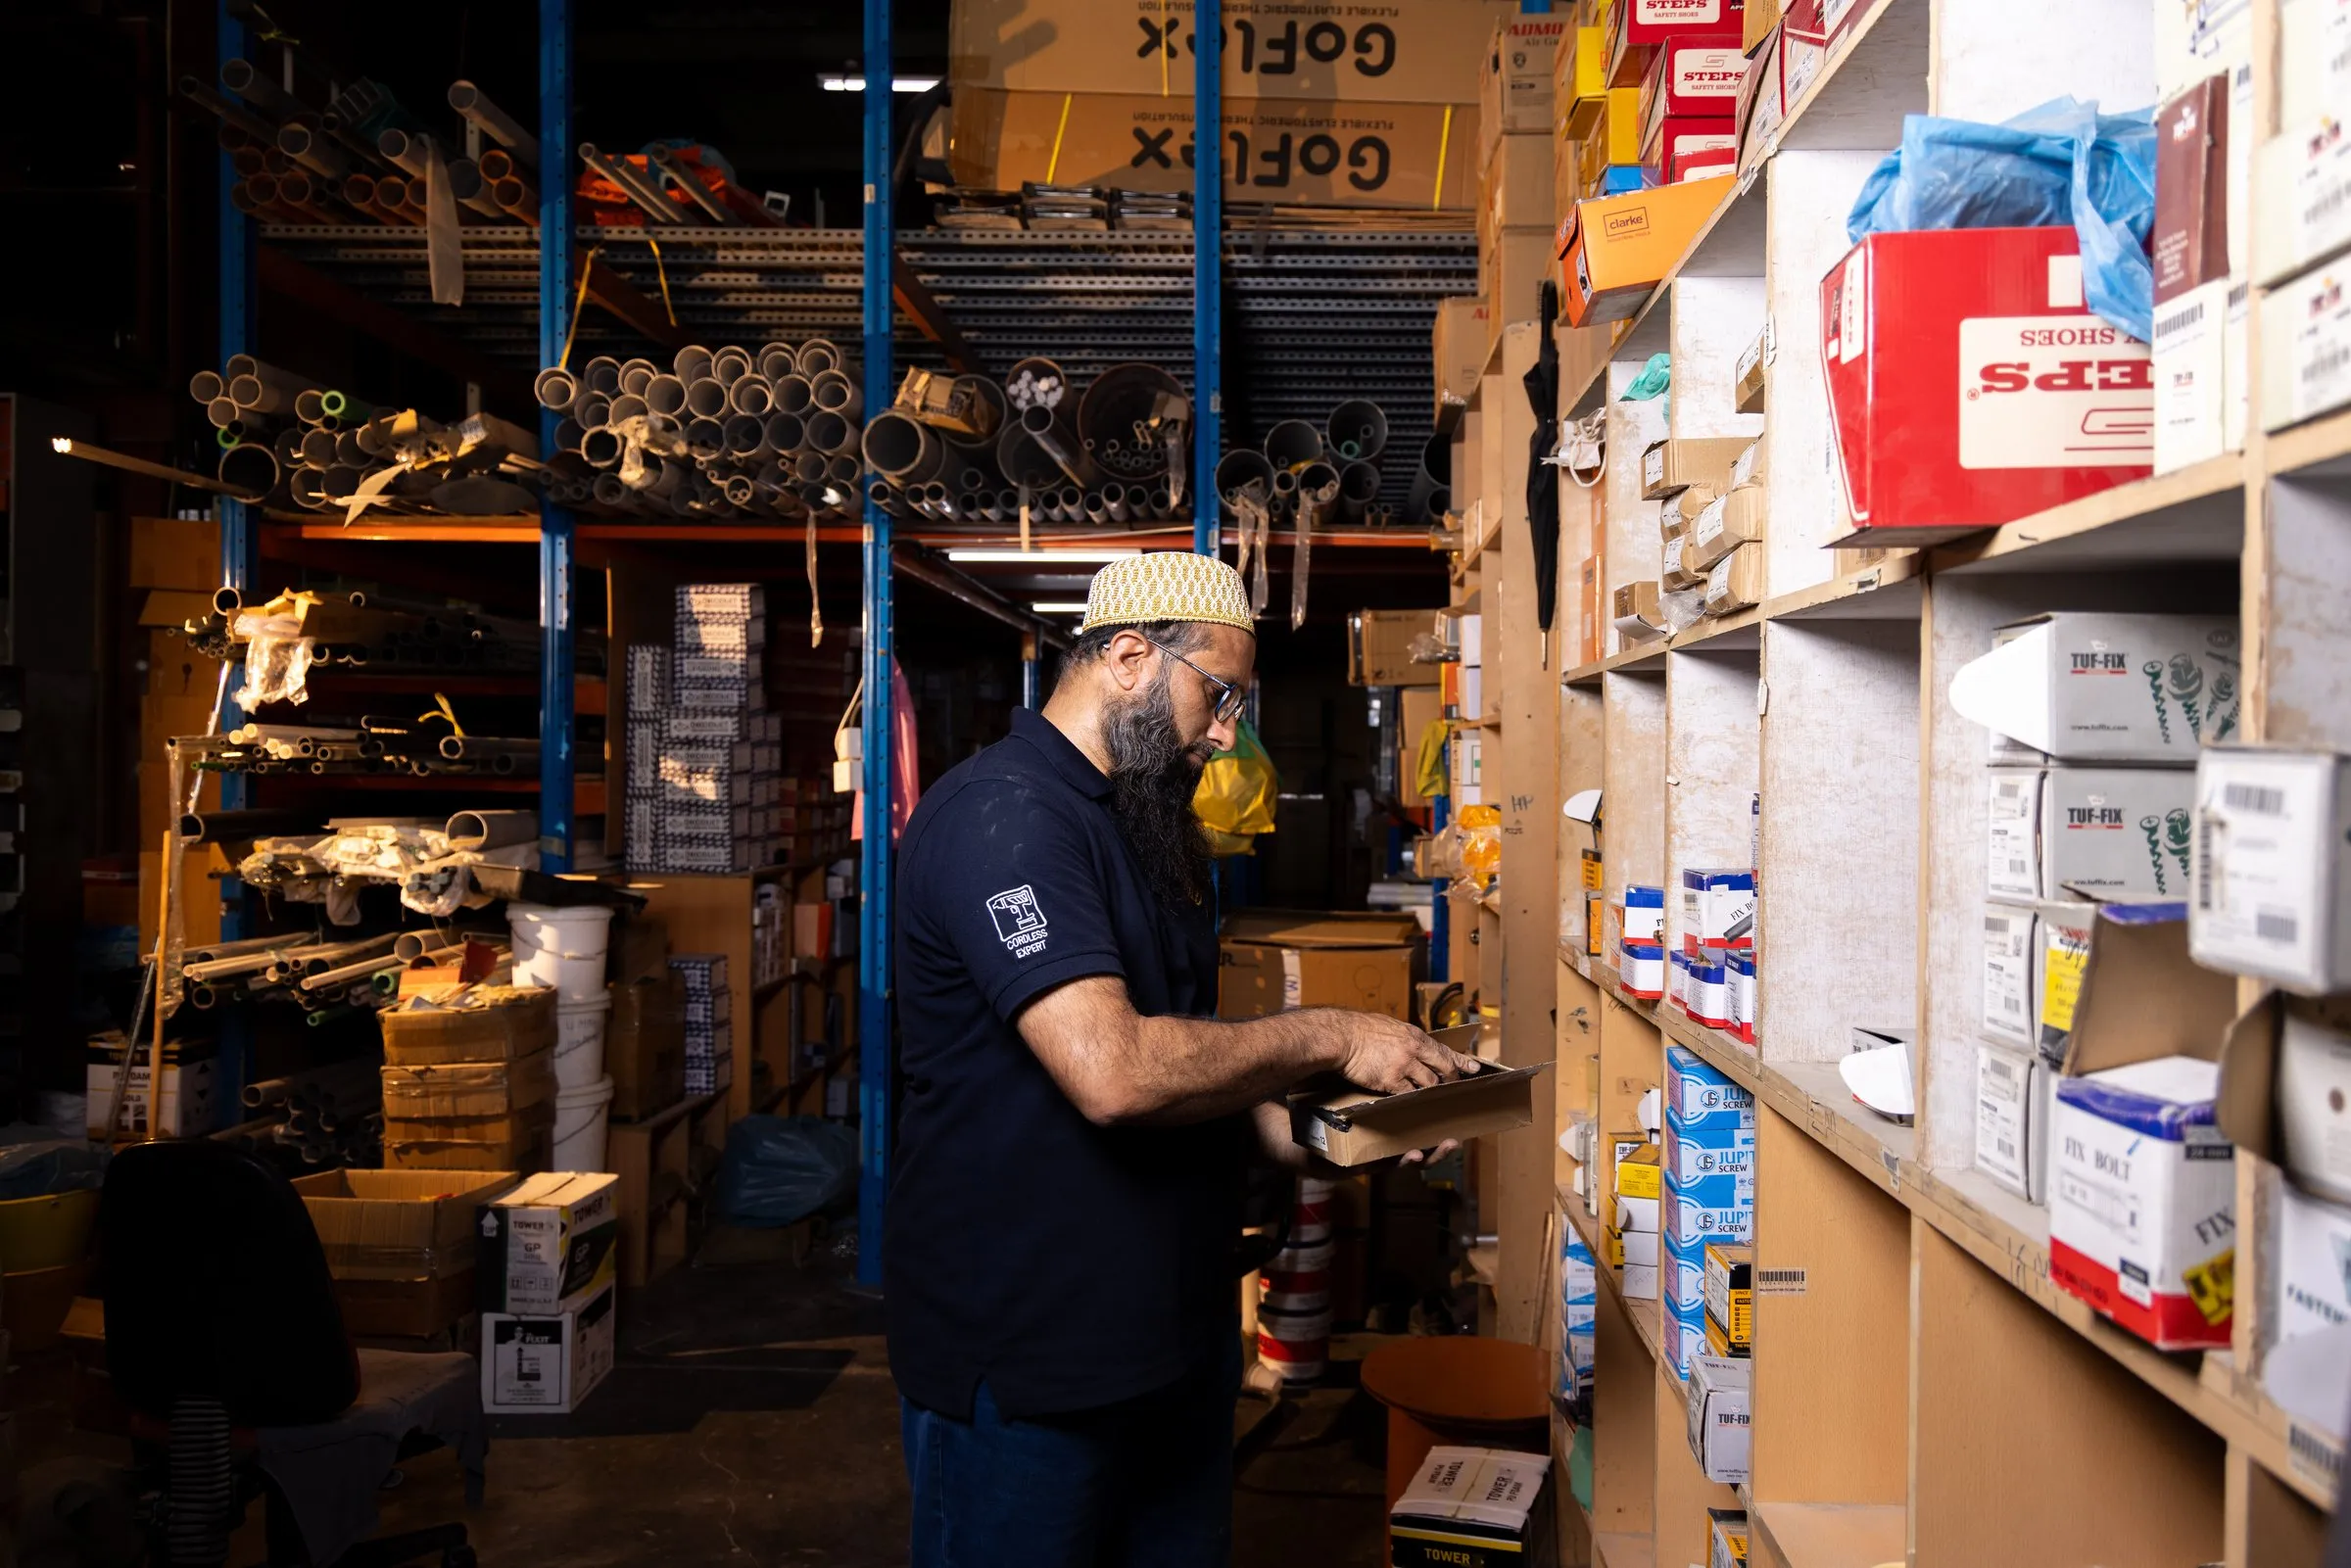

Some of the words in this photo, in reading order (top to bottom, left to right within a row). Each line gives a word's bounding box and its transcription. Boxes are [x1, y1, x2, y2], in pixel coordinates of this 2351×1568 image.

[1264, 4, 1343, 16] ELASTOMERIC
[1646, 0, 1707, 9] STEPS
[1348, 7, 1399, 18] FLEXIBLE
[1684, 71, 1744, 81] STEPS
[1132, 111, 1194, 122] NSULATION
[1258, 116, 1338, 128] ELASTOMERIC
[1342, 119, 1394, 130] FLEXIBLE
[1609, 215, 1644, 229] clarke
[2021, 327, 2115, 346] SHOES
[1980, 359, 2153, 393] EPS
[2071, 652, 2127, 669] TUF-FIX
[2067, 807, 2124, 824] TUF-FIX
[1730, 907, 1745, 921] FIX
[1006, 928, 1048, 950] CORDLESS
[1016, 939, 1047, 959] EXPERT
[1719, 1151, 1754, 1164] JUPIT
[2065, 1136, 2086, 1163] FIX
[2094, 1148, 2133, 1183] BOLT
[1718, 1164, 1748, 1173] SCREW
[513, 1220, 544, 1230] TOWER
[1717, 1224, 1747, 1233] SCREW
[2194, 1206, 2234, 1245] FIX
[524, 1243, 541, 1253] GP
[2286, 1284, 2351, 1322] FASTEN
[1486, 1476, 1508, 1501] TOWER
[1424, 1547, 1470, 1566] TOWER
